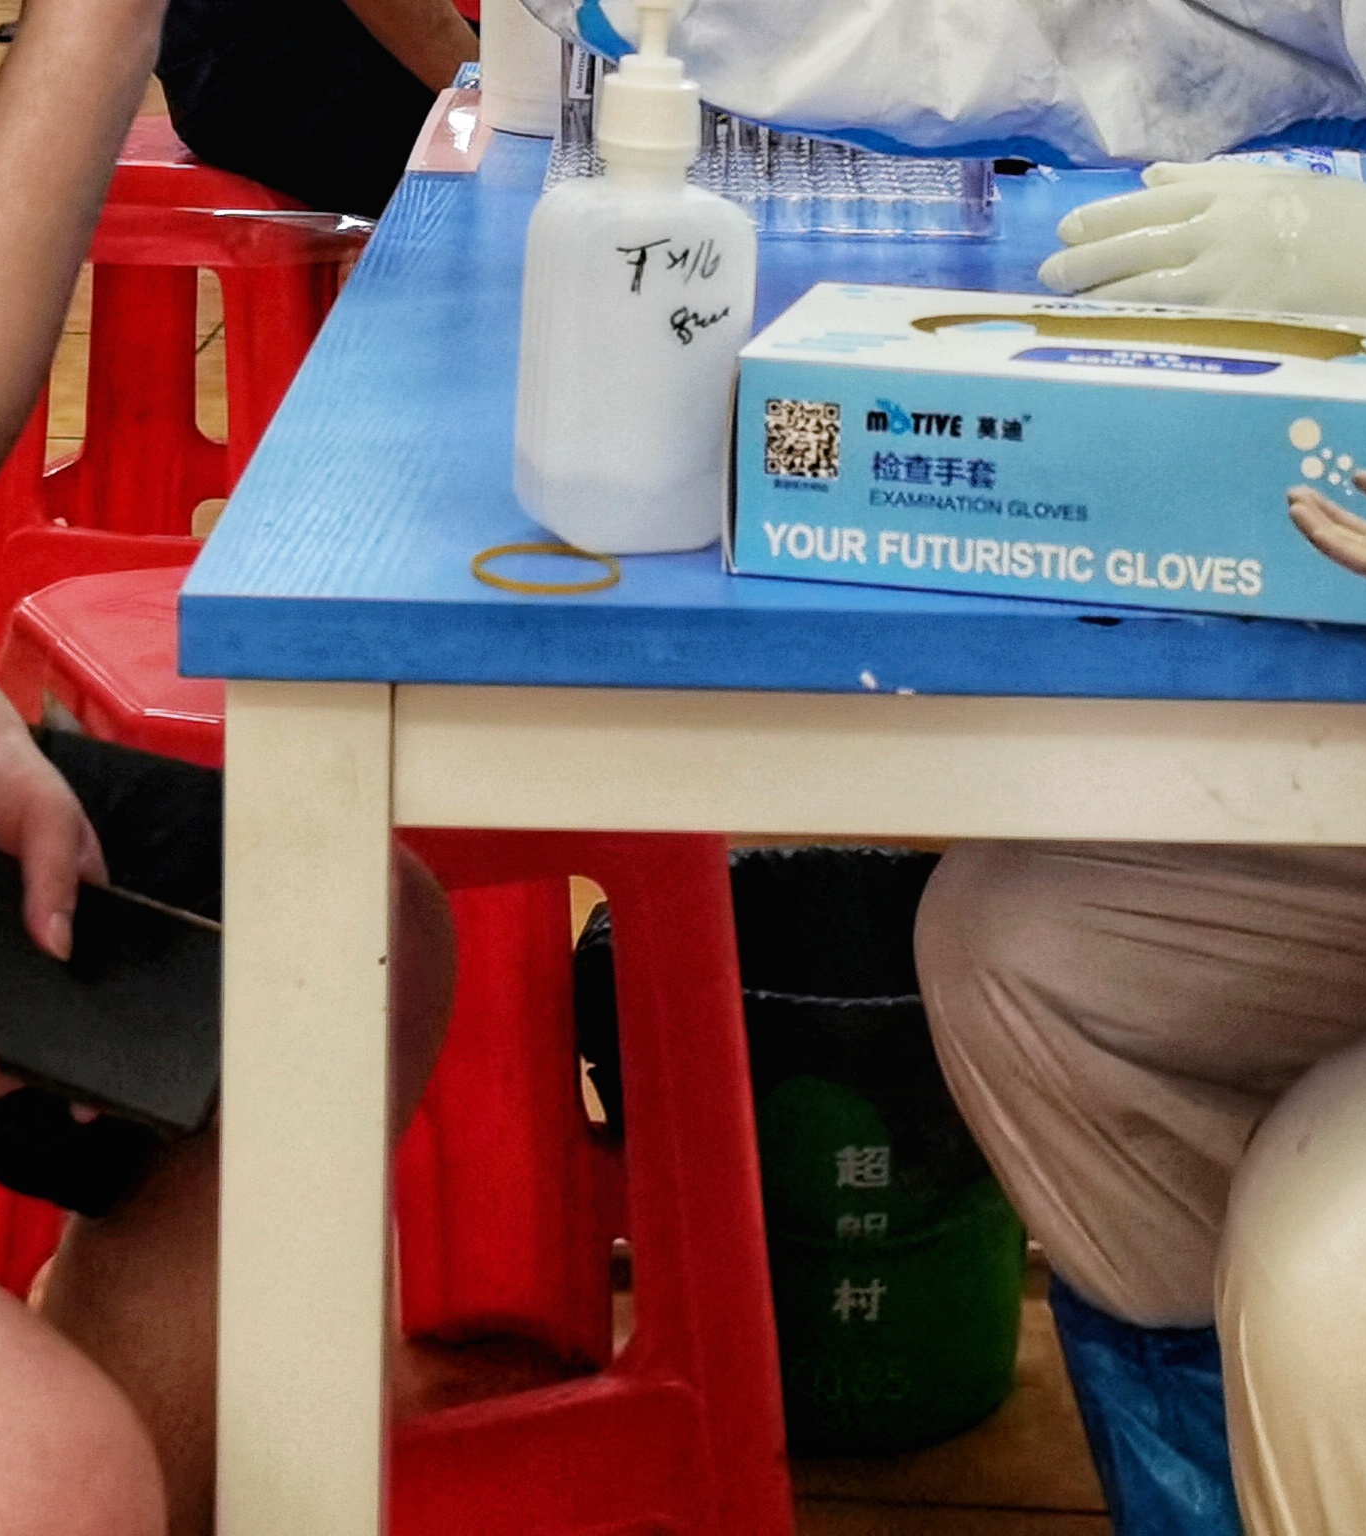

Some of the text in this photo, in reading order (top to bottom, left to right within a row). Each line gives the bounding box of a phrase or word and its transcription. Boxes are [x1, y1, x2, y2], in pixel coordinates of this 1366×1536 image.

[872, 452, 997, 489] 检查手套
[870, 489, 1088, 522] EXAMINATION GLOVES
[763, 522, 1263, 596] YOUR FUTURISTIC GLOVES
